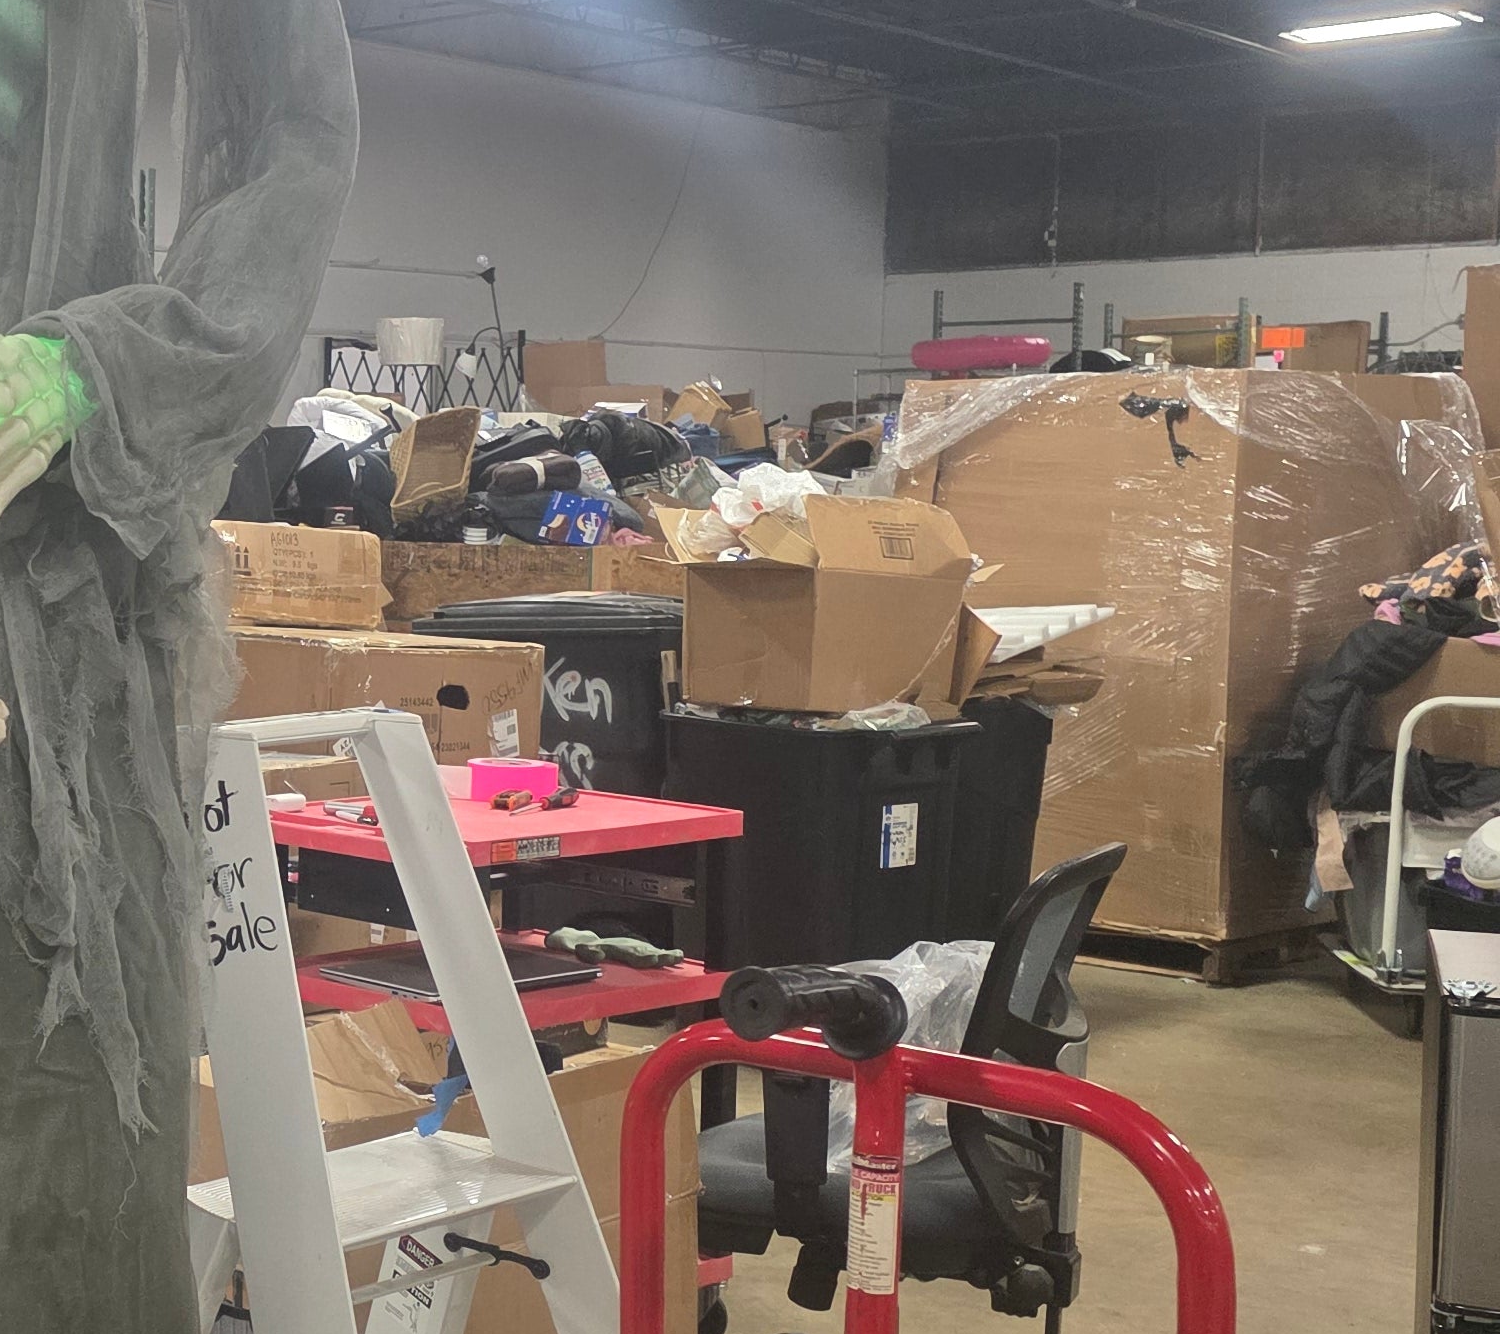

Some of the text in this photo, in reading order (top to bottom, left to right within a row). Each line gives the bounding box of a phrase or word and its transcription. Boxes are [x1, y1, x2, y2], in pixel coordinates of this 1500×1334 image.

[203, 780, 239, 832] ot
[211, 857, 253, 898] or
[406, 1240, 435, 1268] DANGER
